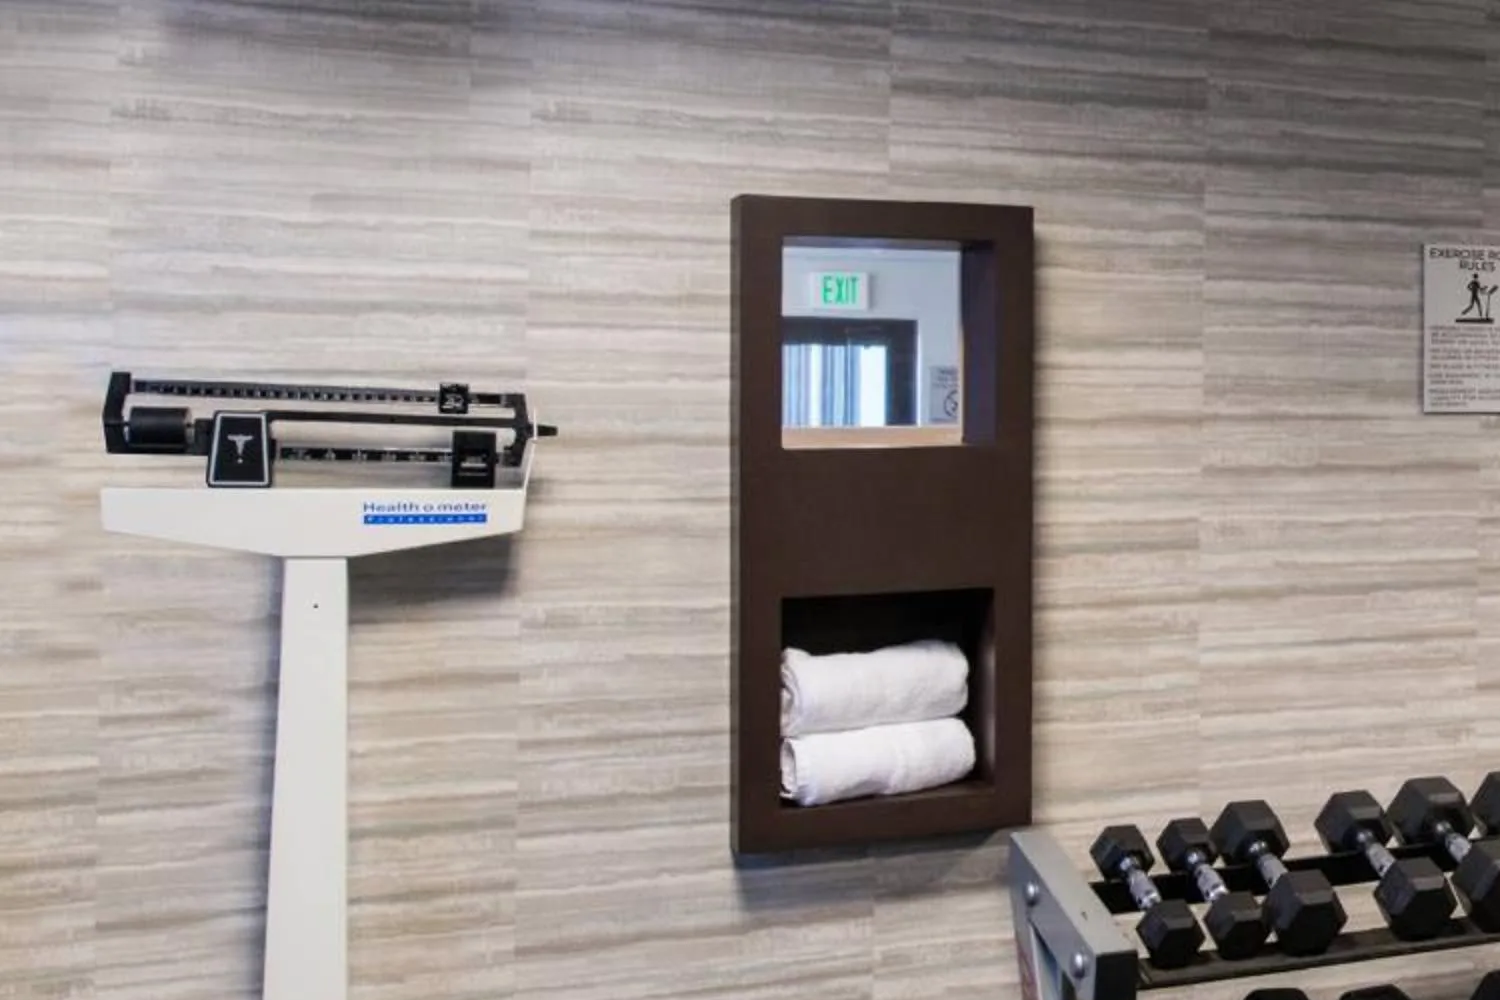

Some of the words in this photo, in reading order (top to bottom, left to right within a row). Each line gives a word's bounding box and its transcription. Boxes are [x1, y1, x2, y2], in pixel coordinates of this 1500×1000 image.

[1429, 248, 1484, 260] EXERCISE
[1459, 260, 1496, 272] RULES
[823, 275, 859, 304] EXIT
[363, 501, 419, 513] Health
[437, 501, 486, 512] meter
